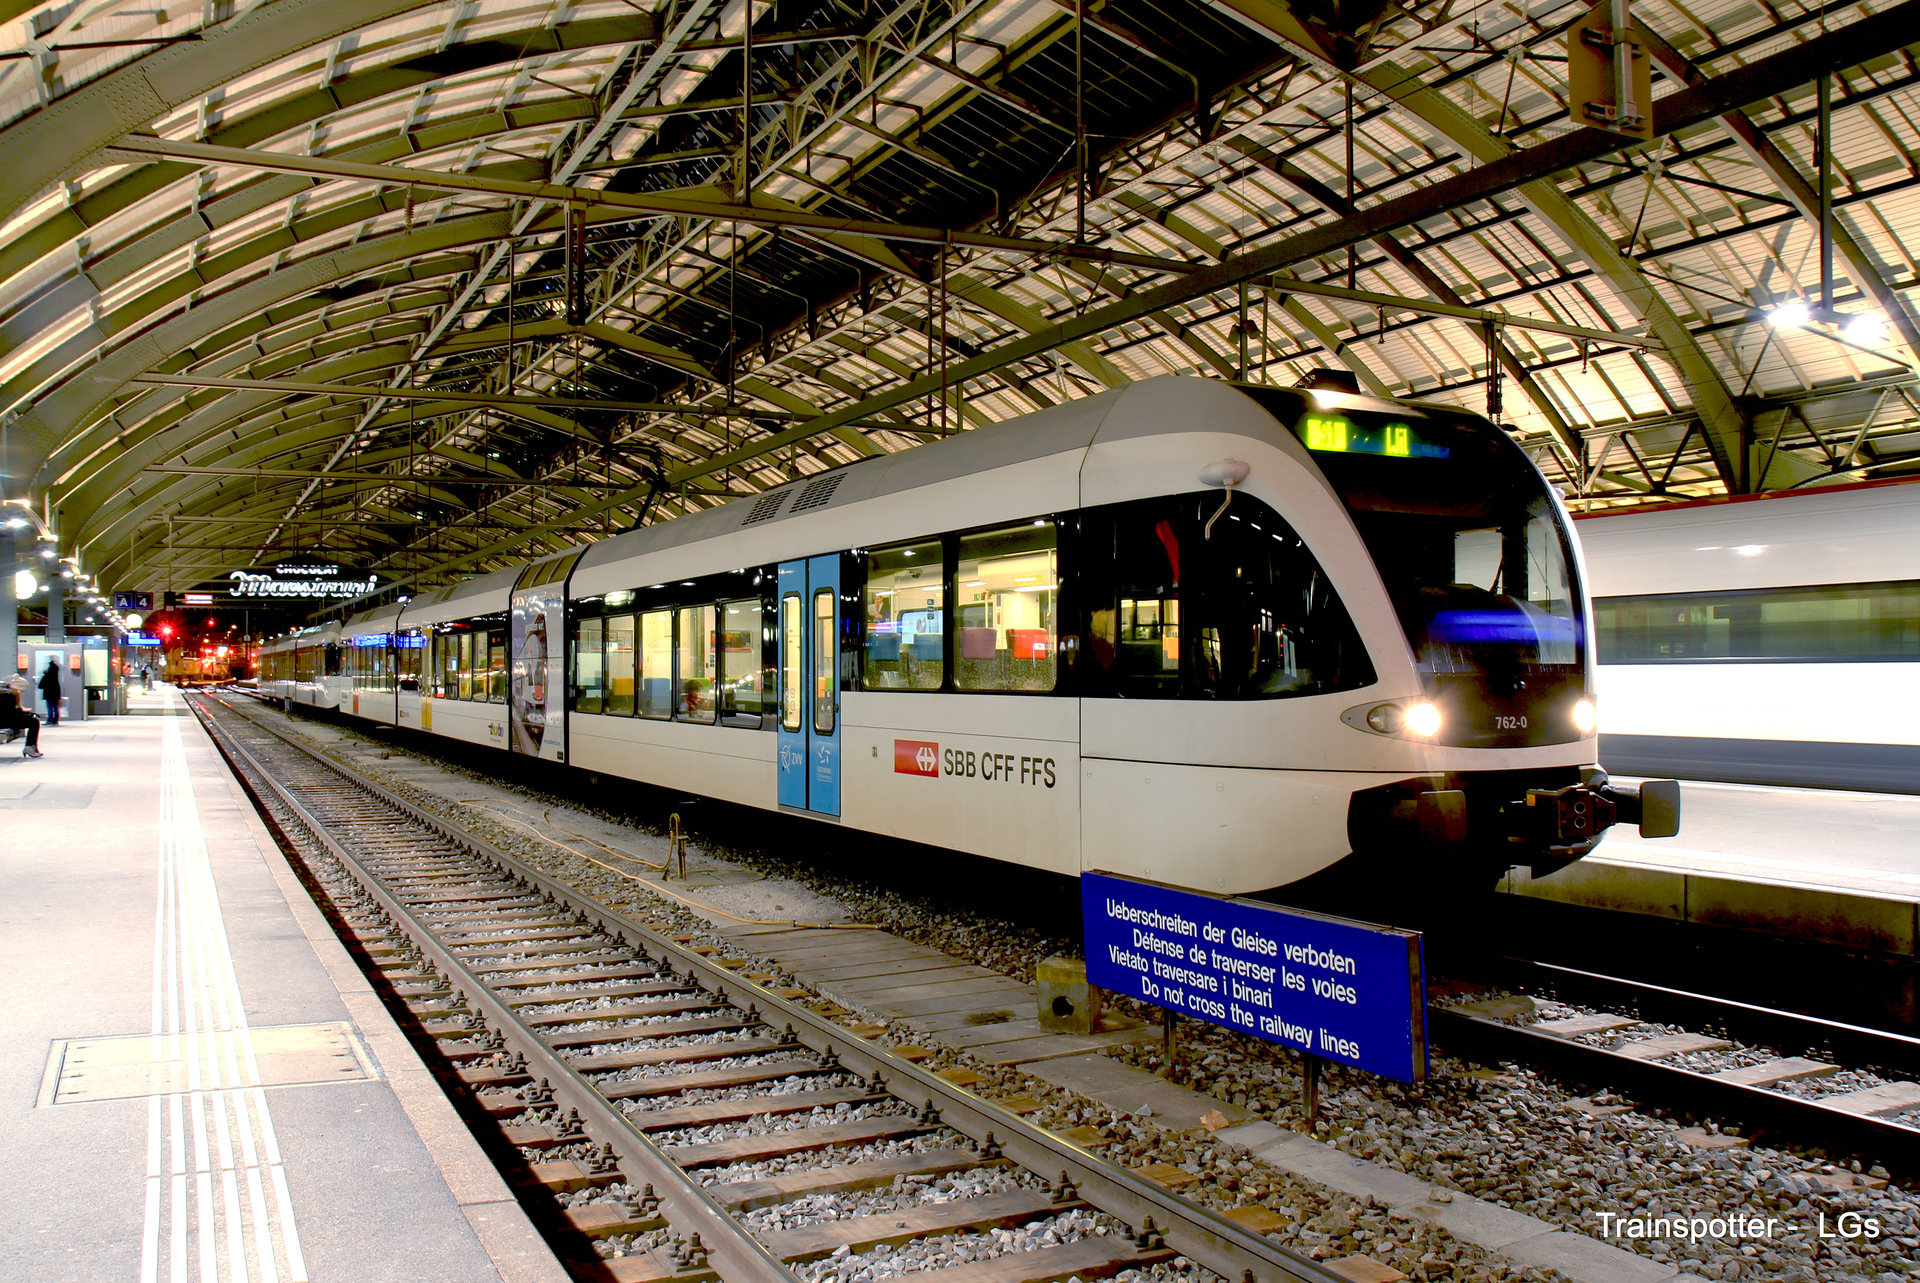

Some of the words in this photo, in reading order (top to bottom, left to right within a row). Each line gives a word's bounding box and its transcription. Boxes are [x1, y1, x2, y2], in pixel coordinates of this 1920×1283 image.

[119, 597, 129, 607] A
[139, 597, 148, 607] 4
[1495, 715, 1527, 729] 762-0
[791, 752, 803, 766] ZVV
[944, 748, 976, 778] SBB
[981, 752, 1014, 782] CFF
[1021, 756, 1056, 789] FFS
[1106, 898, 1198, 937] Ueberschreiten
[1203, 921, 1226, 944] der
[1231, 927, 1278, 956] Gleise
[1284, 943, 1356, 975] verboten
[1108, 944, 1149, 972] Vietato
[1152, 956, 1218, 992] traversare
[1222, 975, 1228, 995] i
[1232, 978, 1273, 1008] binari
[1133, 928, 1185, 959] Défense
[1189, 944, 1207, 965] de
[1212, 949, 1276, 984] traverser
[1282, 966, 1306, 991] les
[1312, 977, 1357, 1005] voies
[1142, 976, 1160, 998] Do
[1163, 986, 1184, 1007] not
[1188, 995, 1226, 1019] cross
[1230, 1002, 1255, 1028] the
[1260, 1015, 1313, 1048] railway
[1320, 1028, 1360, 1060] lines
